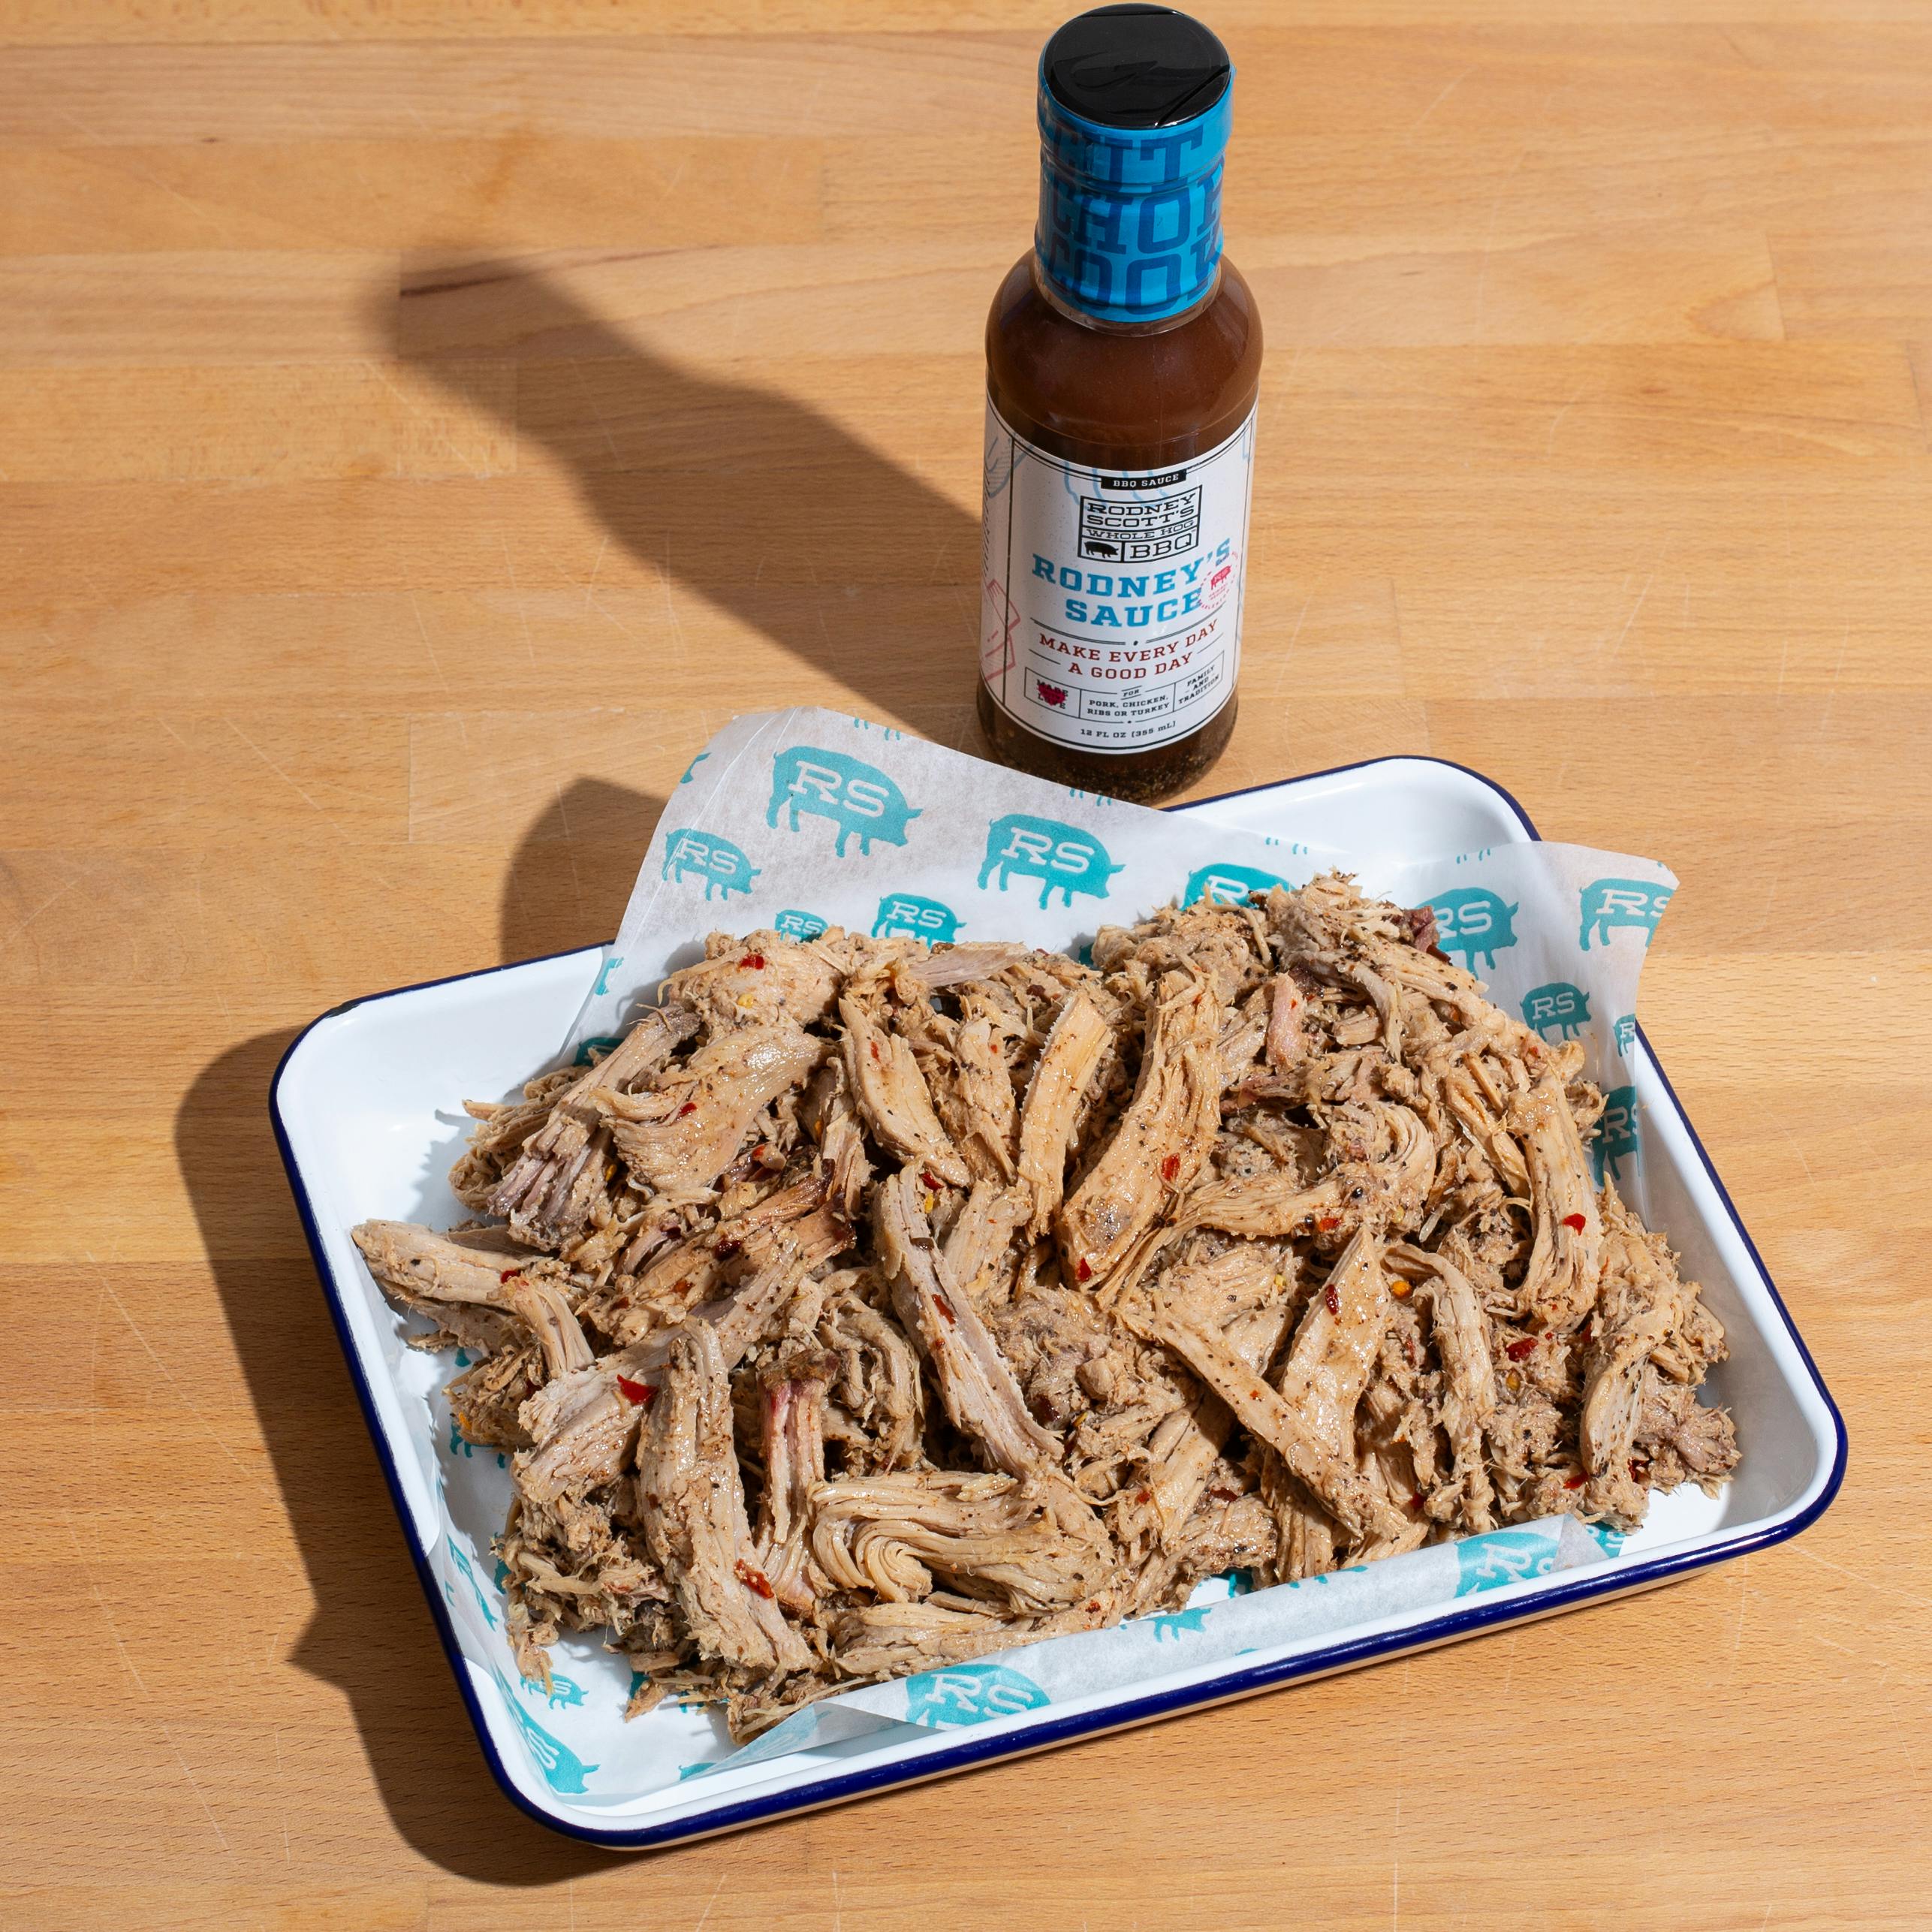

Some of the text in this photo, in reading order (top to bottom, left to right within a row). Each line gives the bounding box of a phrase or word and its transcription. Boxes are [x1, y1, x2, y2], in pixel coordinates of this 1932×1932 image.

[1141, 473, 1180, 487] SAUCE
[1087, 493, 1196, 516] RODNEY
[1087, 505, 1195, 528] SCOTT'S
[1086, 520, 1194, 540] WHOLE HOG
[1129, 532, 1192, 559] BBQ
[1032, 537, 1231, 598] RODNEY'S
[1065, 587, 1202, 628] SAUCE
[1039, 618, 1218, 662] MAKE EVERY DAY
[1068, 652, 1193, 680] A GOOD DAY
[1187, 665, 1214, 687] FAMILY
[1123, 689, 1140, 697] FOR
[1178, 674, 1219, 704] TRADITION
[1193, 676, 1209, 691] AND
[1087, 708, 1111, 716] RIBS
[1131, 703, 1170, 716] TURKEY
[1081, 728, 1093, 737] 12
[788, 760, 890, 818] RS
[677, 838, 739, 875] RS
[1000, 826, 1095, 874] RS
[781, 914, 823, 934] RS
[887, 900, 947, 929] RS
[1531, 991, 1576, 1020] RS
[924, 1673, 1035, 1720] RS
